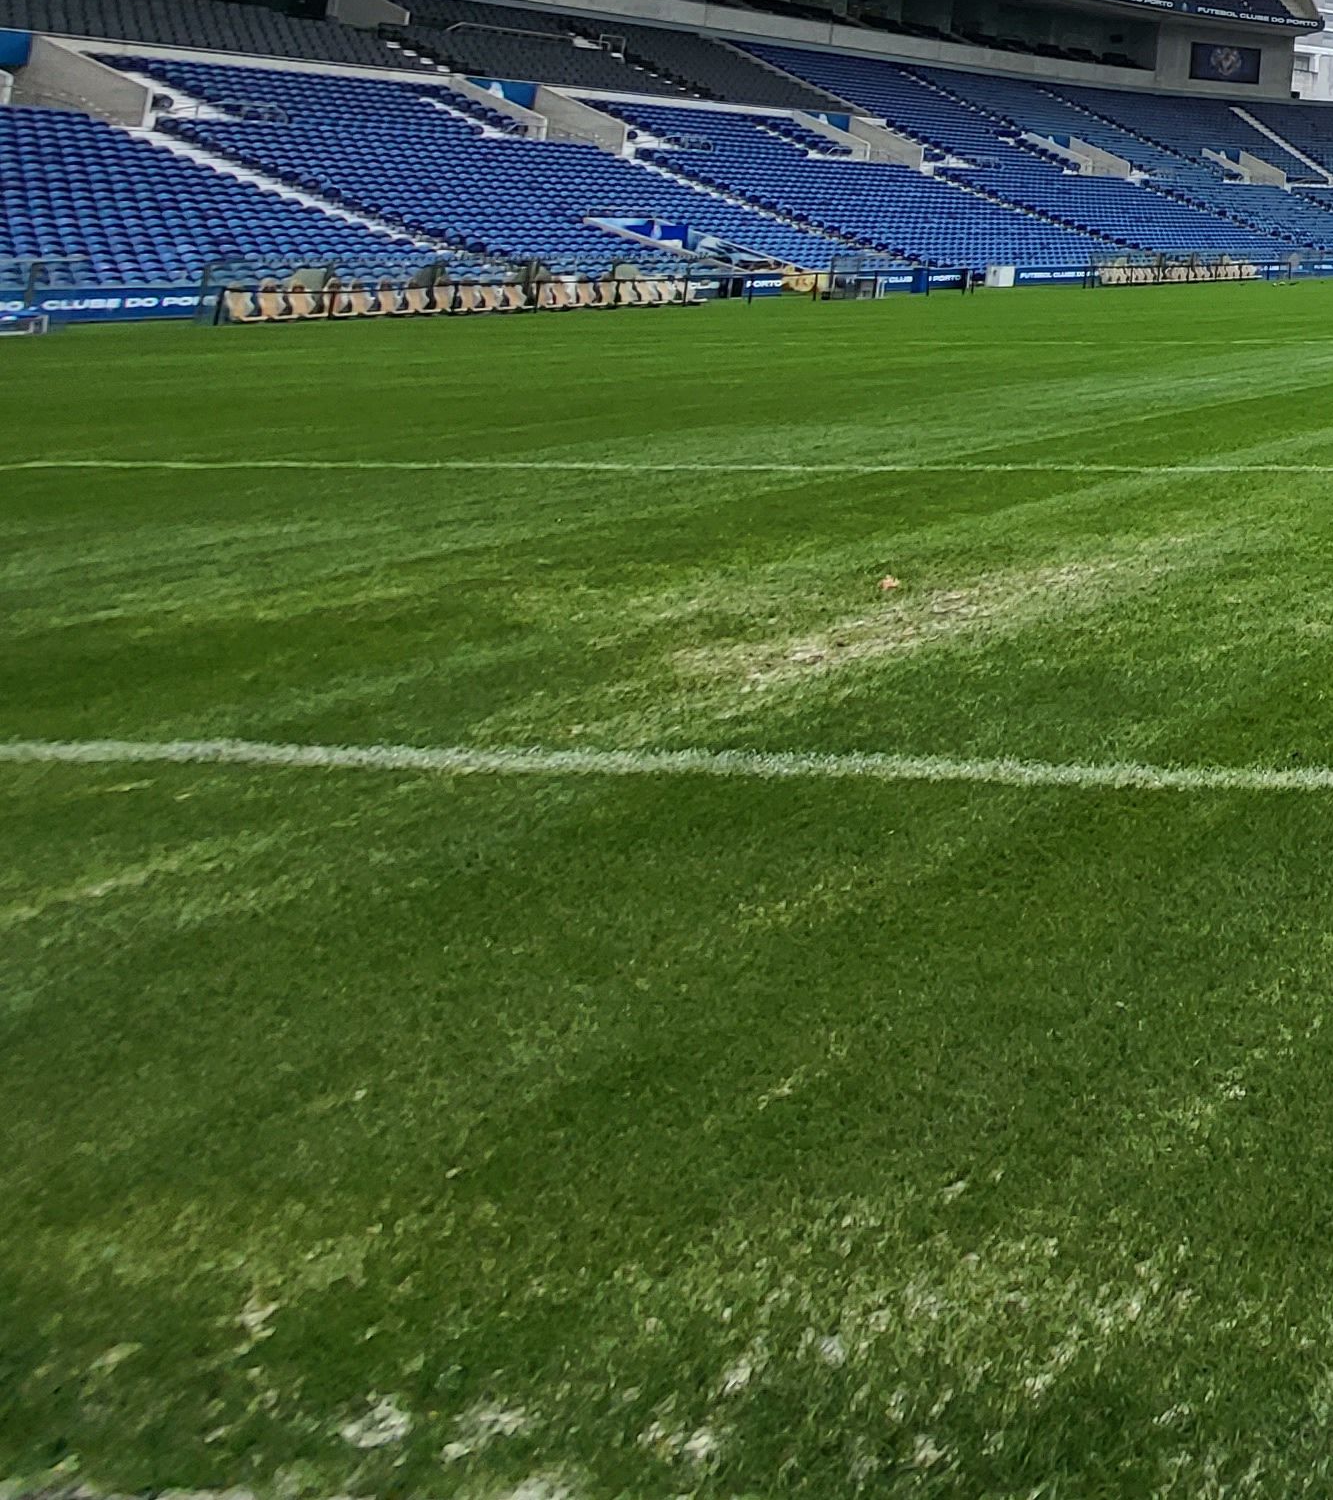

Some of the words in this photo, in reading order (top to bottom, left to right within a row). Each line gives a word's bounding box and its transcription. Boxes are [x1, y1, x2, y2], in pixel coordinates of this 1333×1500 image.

[1197, 6, 1239, 18] FUTEBOL
[1239, 12, 1270, 22] CLUBE
[1271, 16, 1285, 24] DO
[1286, 18, 1319, 27] PORTO
[41, 298, 121, 311] CLUBE
[125, 297, 160, 309] DO
